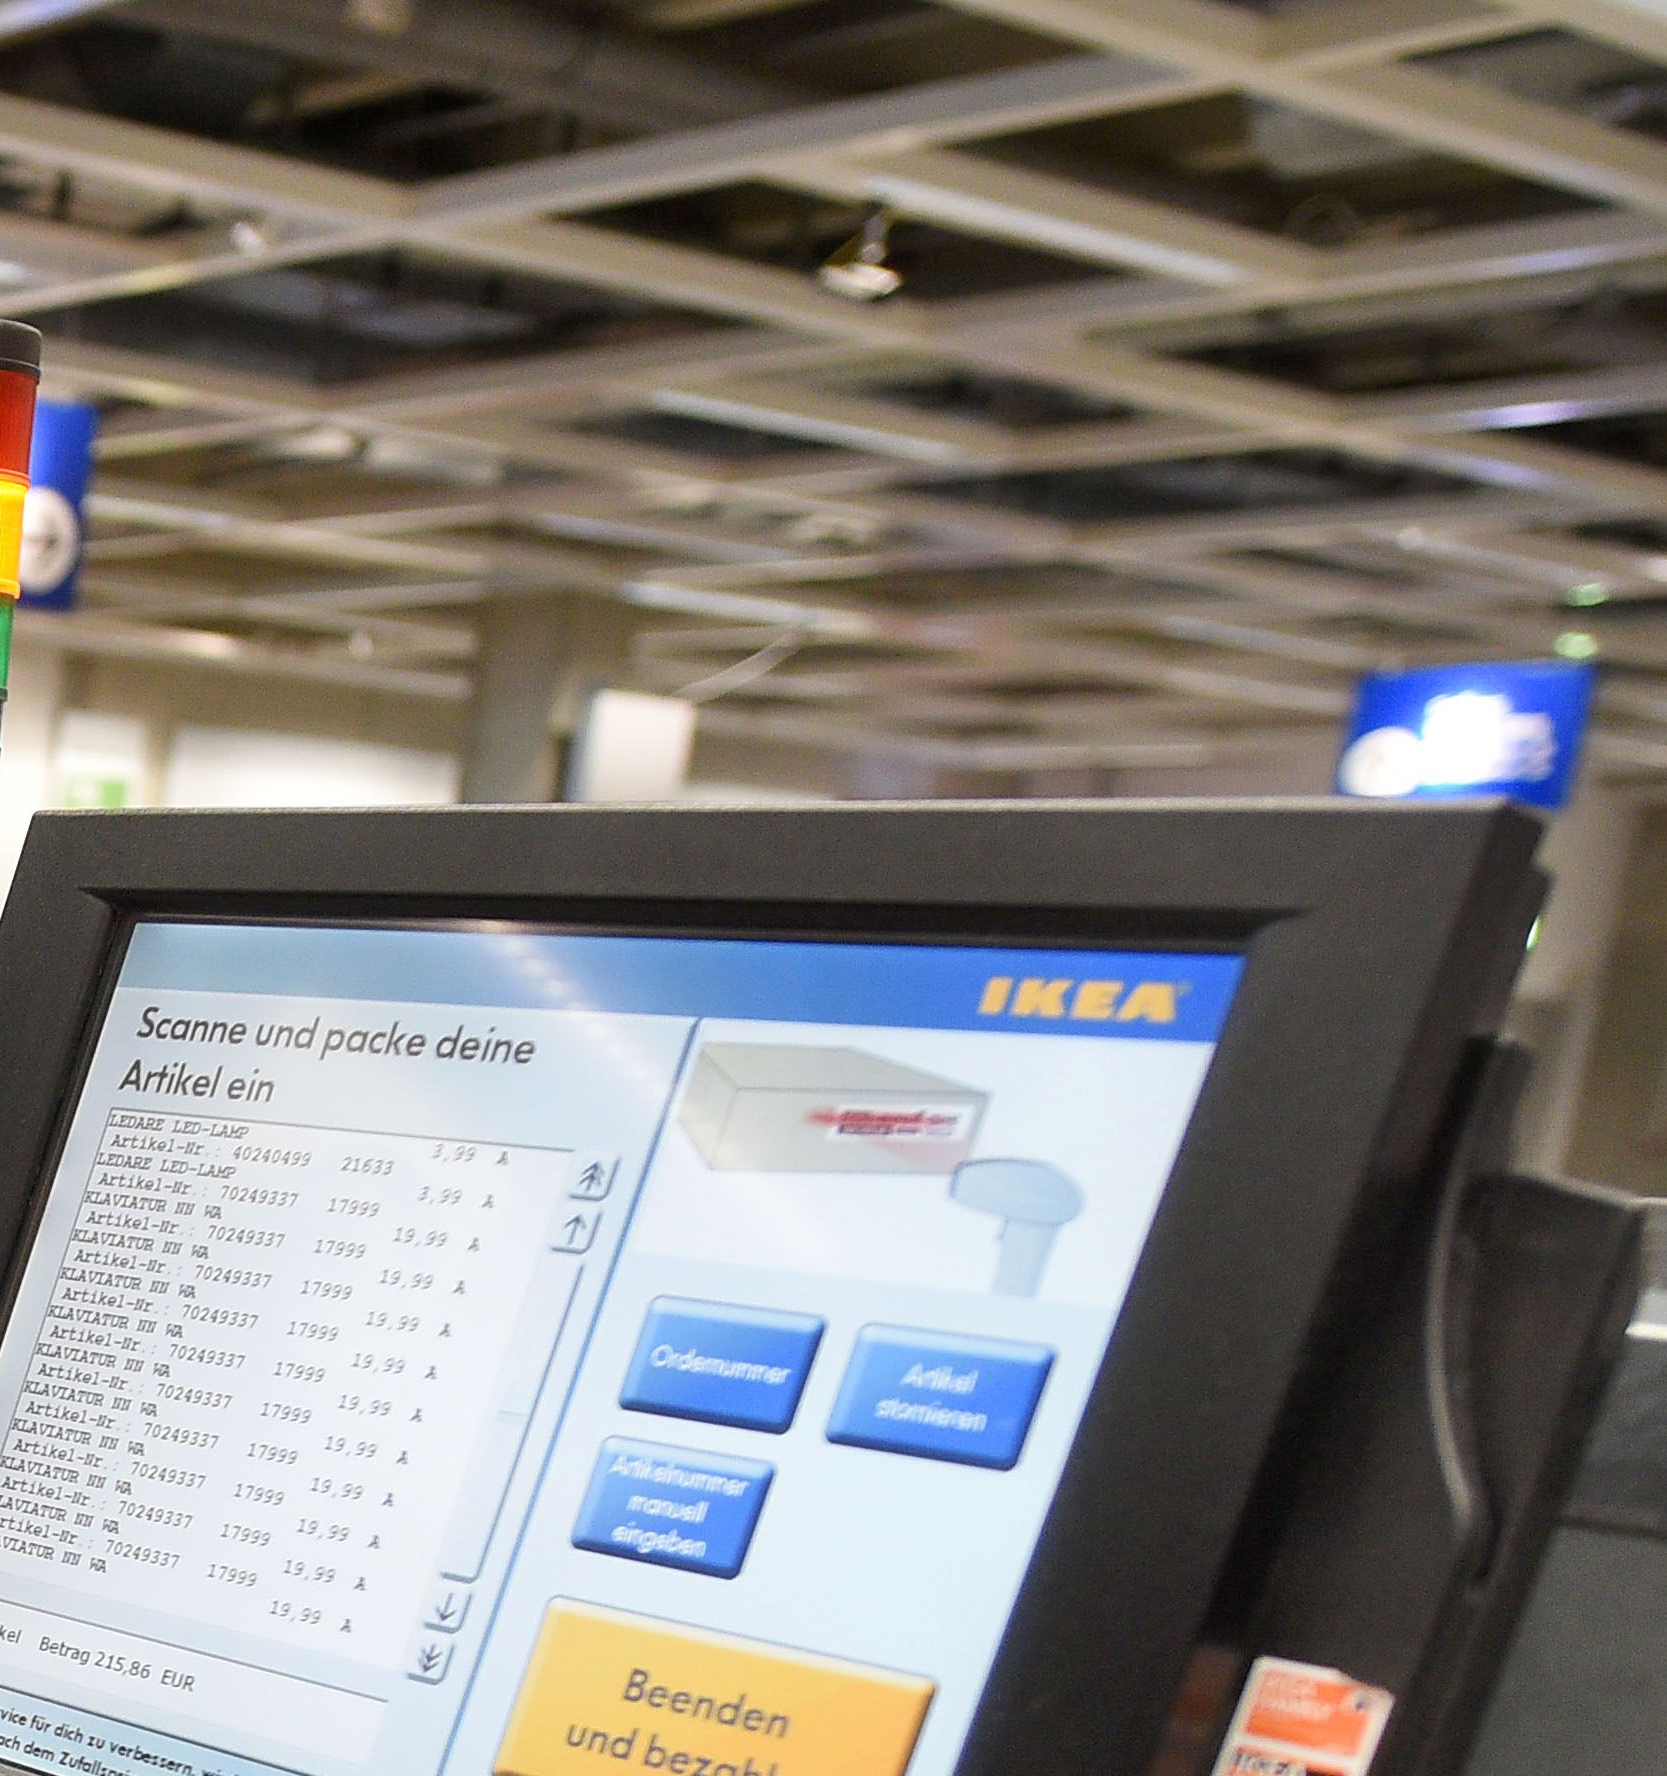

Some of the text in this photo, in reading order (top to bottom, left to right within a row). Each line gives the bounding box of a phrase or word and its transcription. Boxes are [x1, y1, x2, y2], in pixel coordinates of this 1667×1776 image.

[977, 975, 1178, 1023] IKEA
[135, 1006, 535, 1064] Scanne und packe deine
[117, 1058, 274, 1102] Artikel ein
[107, 1111, 165, 1131] LEDARE
[170, 1119, 249, 1139] LED-LAMP
[95, 1149, 153, 1170] LEDARE
[158, 1158, 236, 1179] LED-LAMP
[82, 1188, 167, 1212] KLAVIATUR
[220, 1184, 299, 1207] 70249337
[326, 1197, 380, 1217] 17999
[70, 1226, 154, 1251] KLAVIATUR
[207, 1224, 285, 1248] 70249337
[312, 1238, 365, 1259] 17999
[58, 1264, 142, 1290] KLAVIATUR
[194, 1264, 272, 1288] 70249337
[299, 1279, 352, 1300] 17999
[46, 1302, 129, 1329] KLAVIATUR
[182, 1303, 259, 1328] 70249337
[286, 1320, 338, 1341] 17999
[34, 1342, 116, 1367] KLAVIATUR
[169, 1343, 246, 1368] 70249337
[272, 1361, 324, 1383] 17999
[22, 1378, 104, 1406] KLAVIATUR
[903, 1362, 977, 1394] Artikel
[156, 1382, 233, 1408] 70249337
[259, 1402, 311, 1423] 17999
[10, 1416, 91, 1445] KLAVIATUR
[143, 1421, 219, 1448] 70249337
[246, 1442, 297, 1464] 17999
[0, 1453, 79, 1483] KLAVIATUR
[131, 1460, 206, 1488] 70249337
[232, 1482, 283, 1505] 17999
[118, 1500, 193, 1528] 70249337
[219, 1523, 270, 1546] 17999
[625, 1488, 711, 1525] manuell
[606, 1518, 712, 1564] eingeben
[105, 1538, 180, 1568] 70249337
[206, 1563, 256, 1587] 17999
[38, 1635, 91, 1665] Betrag
[93, 1650, 151, 1679] 215,86
[160, 1668, 195, 1692] EUR
[623, 1669, 790, 1738] Beenden
[21, 1738, 57, 1762] dem
[28, 1713, 52, 1734] für
[52, 1720, 86, 1744] dich
[85, 1734, 106, 1750] zu
[566, 1716, 637, 1761] und
